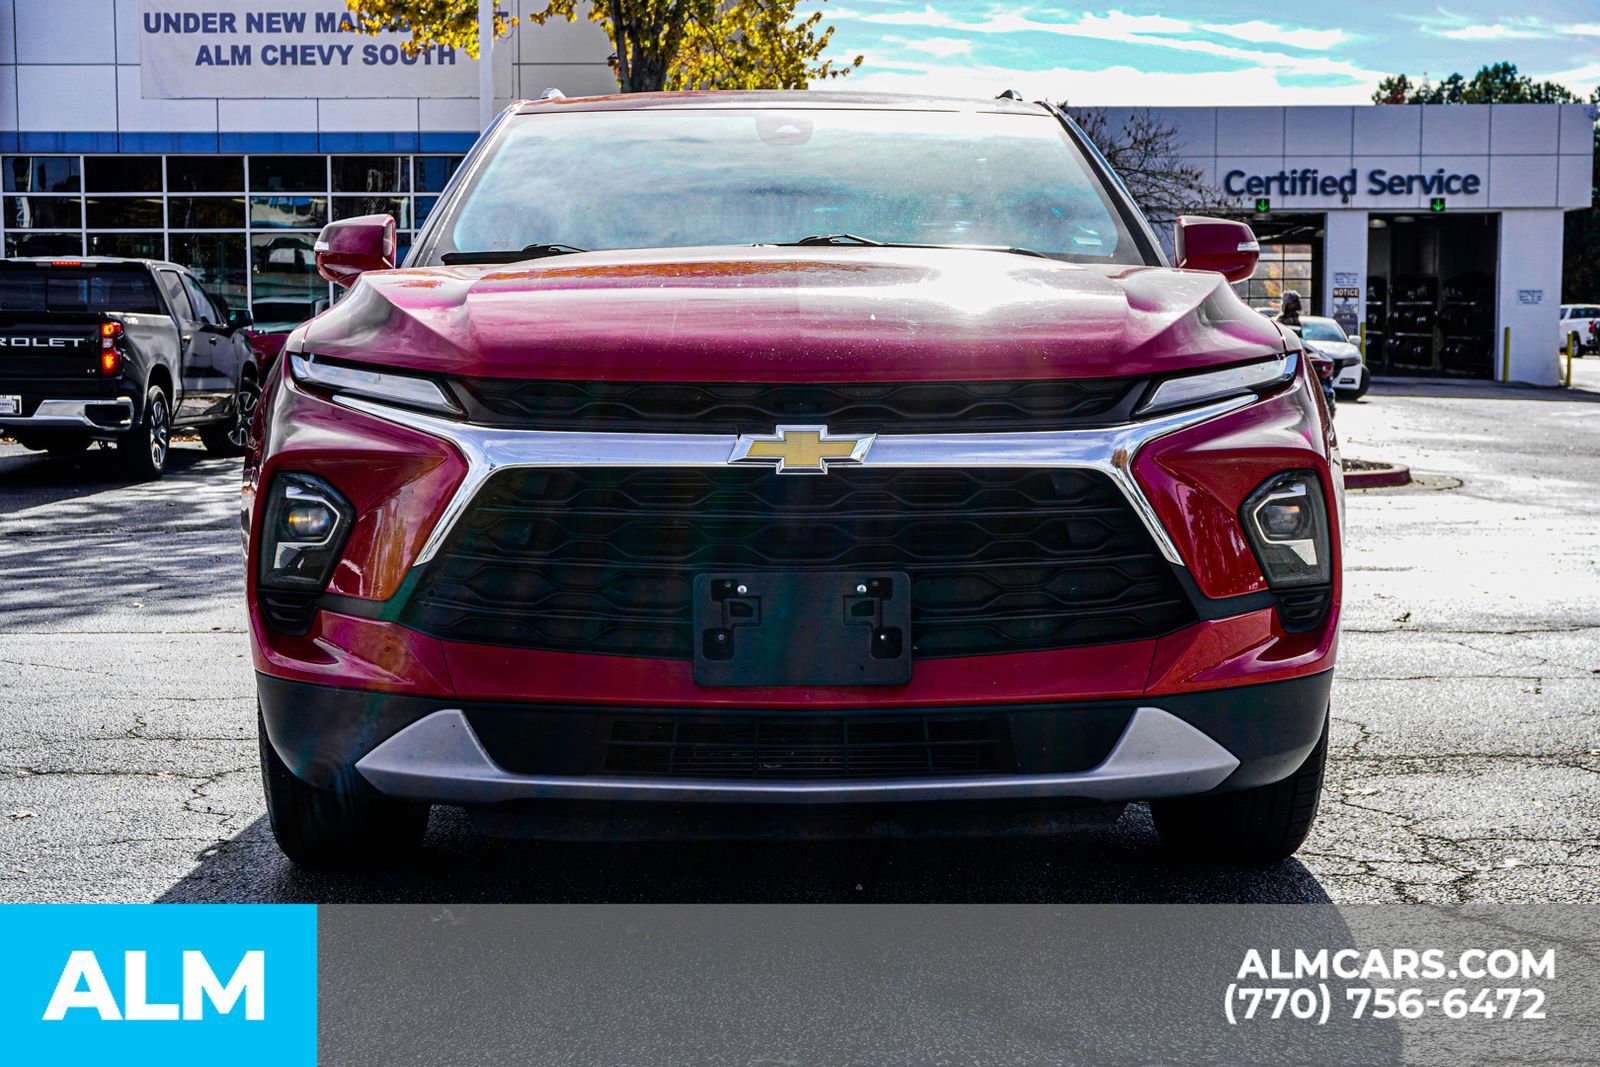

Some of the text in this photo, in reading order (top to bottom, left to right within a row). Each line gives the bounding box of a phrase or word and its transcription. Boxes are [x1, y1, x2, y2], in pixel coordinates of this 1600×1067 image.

[143, 12, 237, 33] UNDER
[245, 12, 306, 33] NEW
[195, 44, 456, 65] ALM CHEVY SOUTH
[1224, 168, 1480, 196] Certified Service
